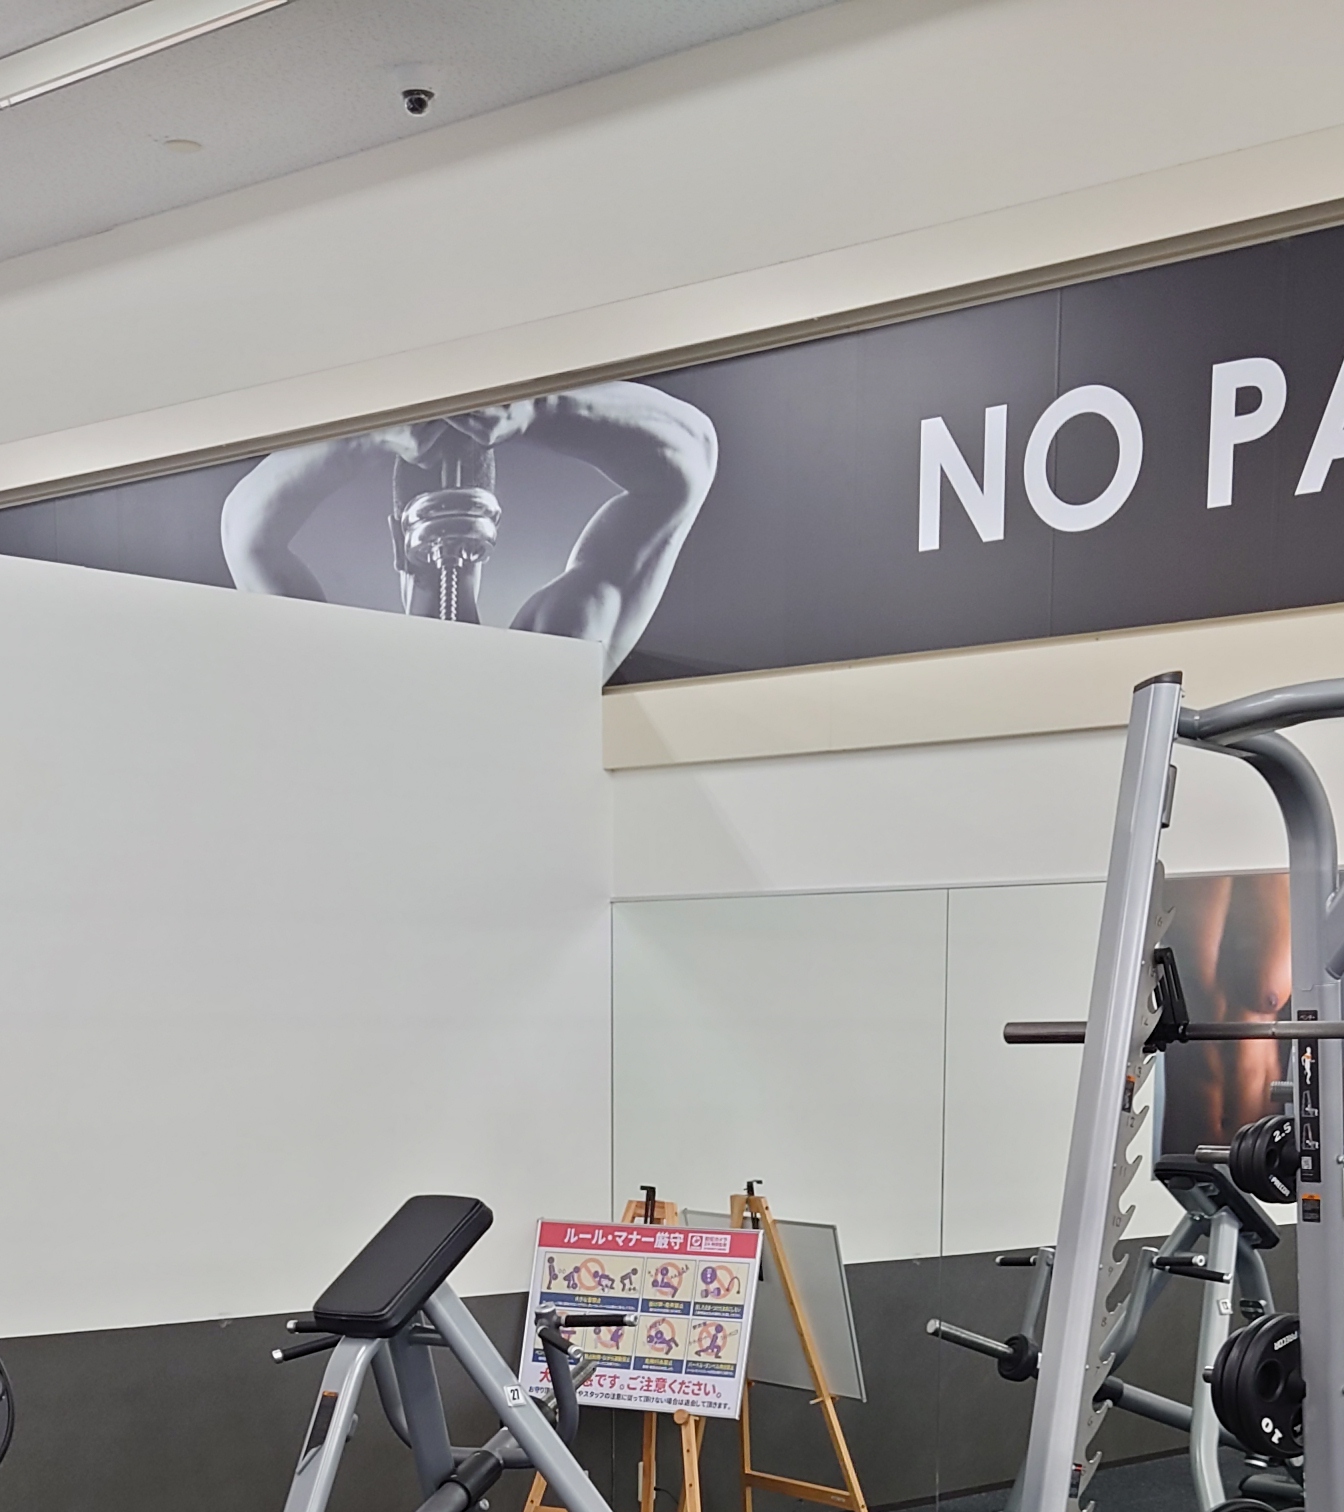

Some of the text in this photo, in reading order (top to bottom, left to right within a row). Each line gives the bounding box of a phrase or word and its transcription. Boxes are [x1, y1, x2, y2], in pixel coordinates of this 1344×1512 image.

[917, 383, 1144, 552] NO
[1273, 1121, 1292, 1142] 2.5
[564, 1228, 684, 1250] ルール・マナー厳守
[1274, 1331, 1298, 1351] PRECOR
[539, 1368, 723, 1399] 大です。ご注意ください。
[510, 1388, 520, 1402] 27
[1261, 1417, 1284, 1444] 10
